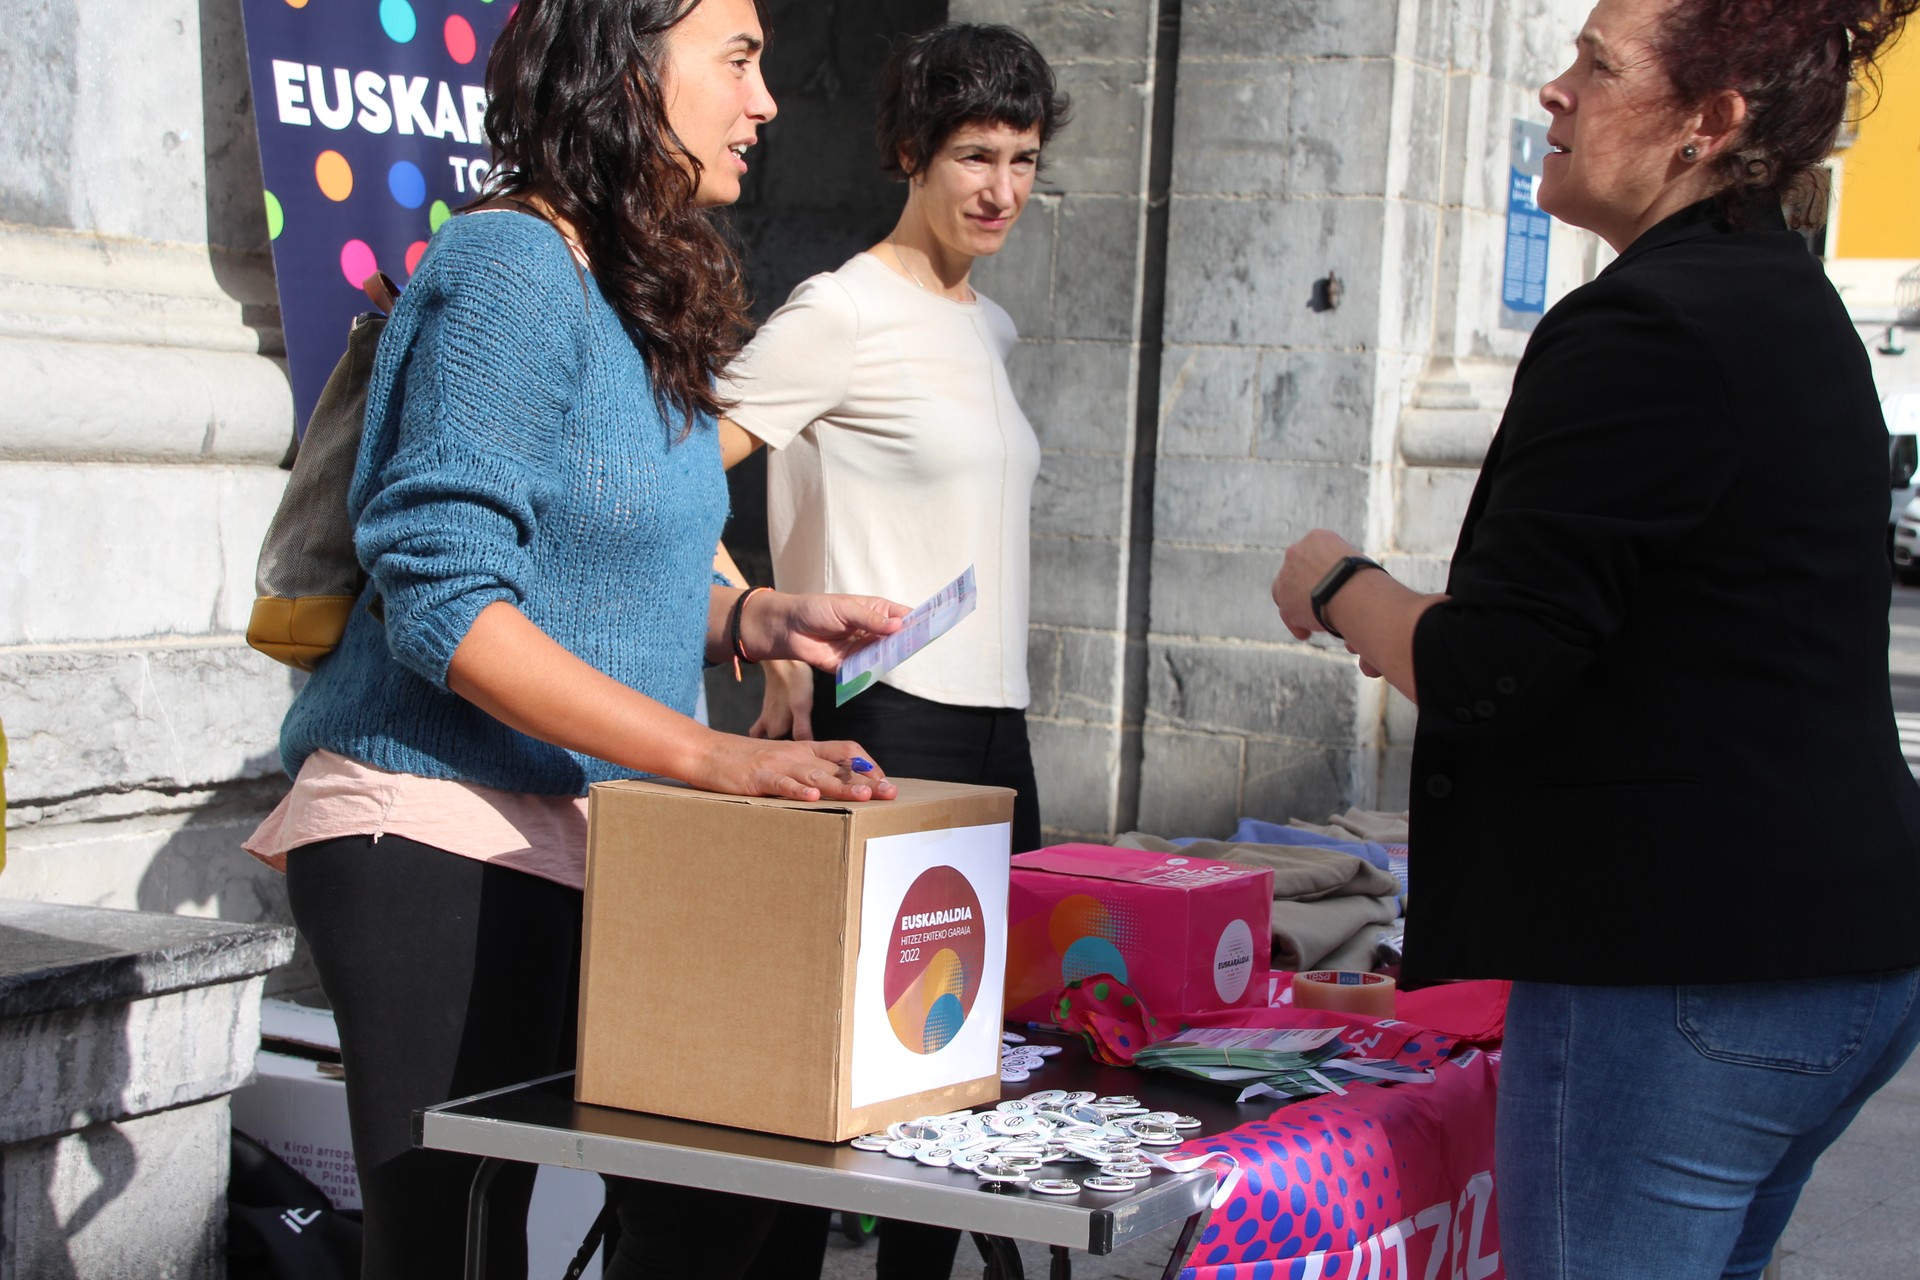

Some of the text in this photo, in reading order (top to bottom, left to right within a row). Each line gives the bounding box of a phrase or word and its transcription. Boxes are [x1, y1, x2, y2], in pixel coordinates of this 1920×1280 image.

[901, 906, 973, 931] EUSKARALDIA
[900, 925, 971, 946] HITZEZ EKITEKO GARAIA
[899, 947, 920, 964] 2022
[1217, 955, 1250, 970] EUSKARALDIA
[284, 1141, 313, 1154] Kirol
[279, 1154, 313, 1167] rako
[322, 1171, 357, 1185] Pinak
